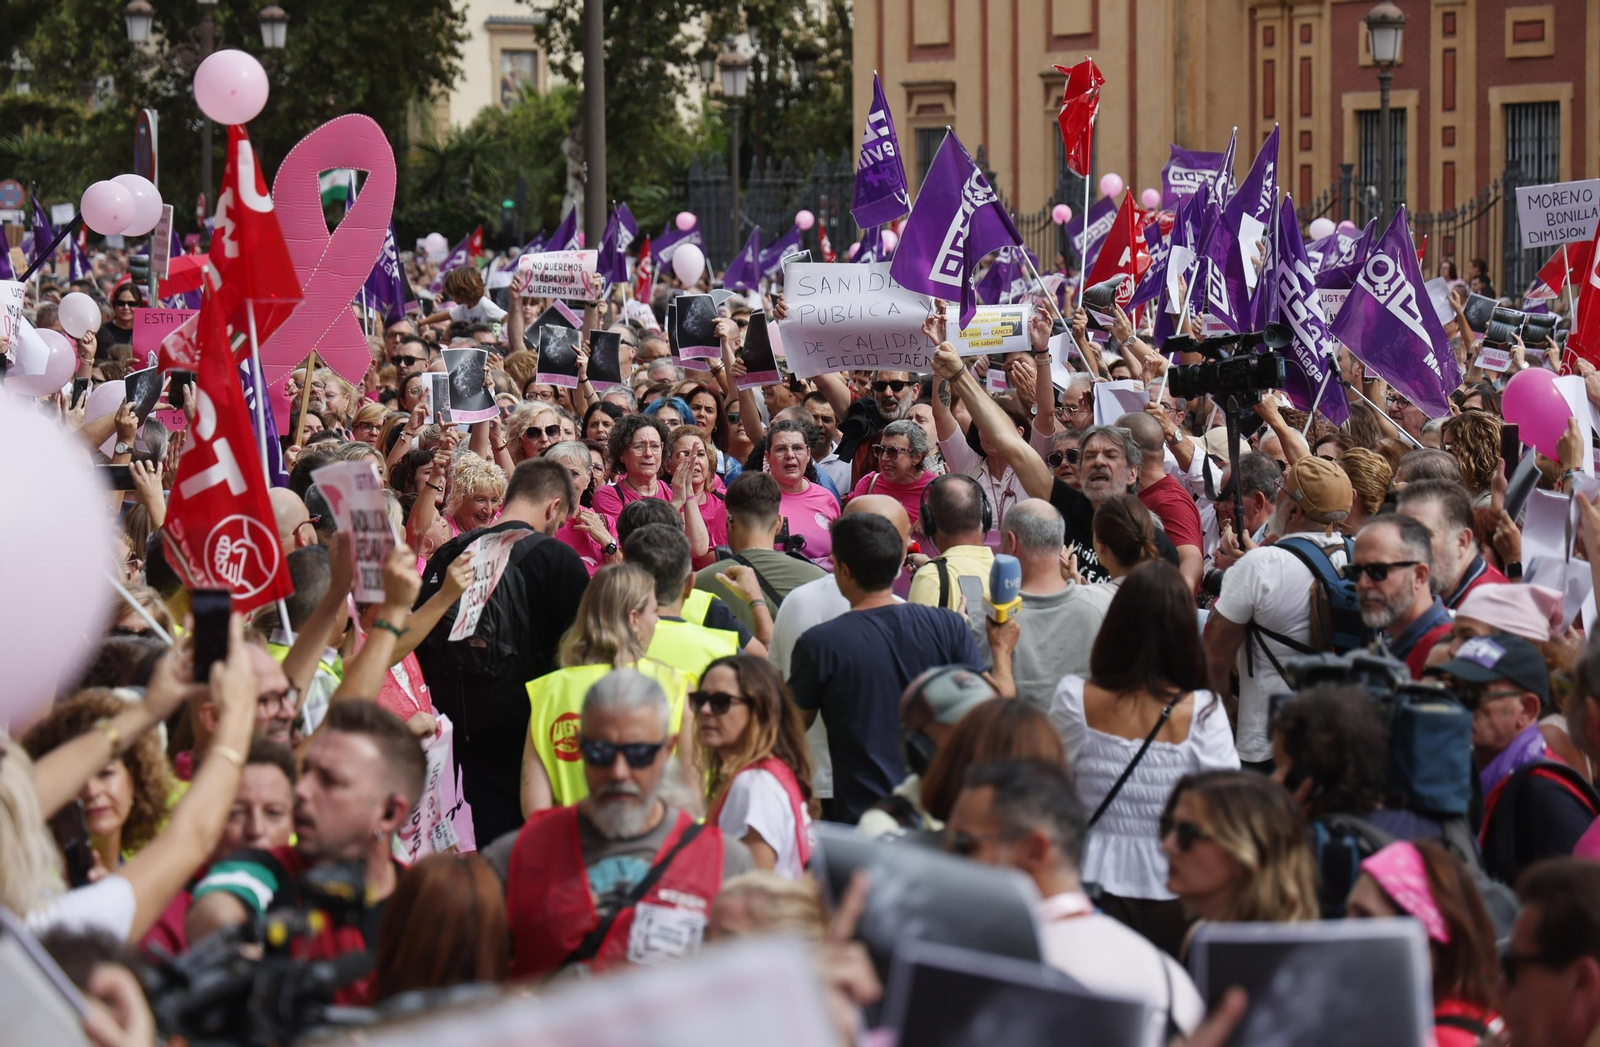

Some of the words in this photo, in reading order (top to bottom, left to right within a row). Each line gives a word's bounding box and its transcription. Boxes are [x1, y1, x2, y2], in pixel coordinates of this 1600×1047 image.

[1528, 189, 1593, 210] MORENO
[1546, 207, 1599, 226] BONILLA
[532, 262, 543, 270] NO
[544, 263, 583, 271] QUEREMOS
[528, 285, 567, 295] QUEREMOS
[568, 288, 586, 296] VIVIR
[1321, 294, 1339, 302] UGT
[144, 312, 174, 324] ESTA
[796, 303, 901, 326] PUBLICA
[919, 299, 933, 322] Y
[803, 341, 827, 355] DE
[827, 354, 879, 369] CCOO
[1291, 334, 1323, 383] Málaga
